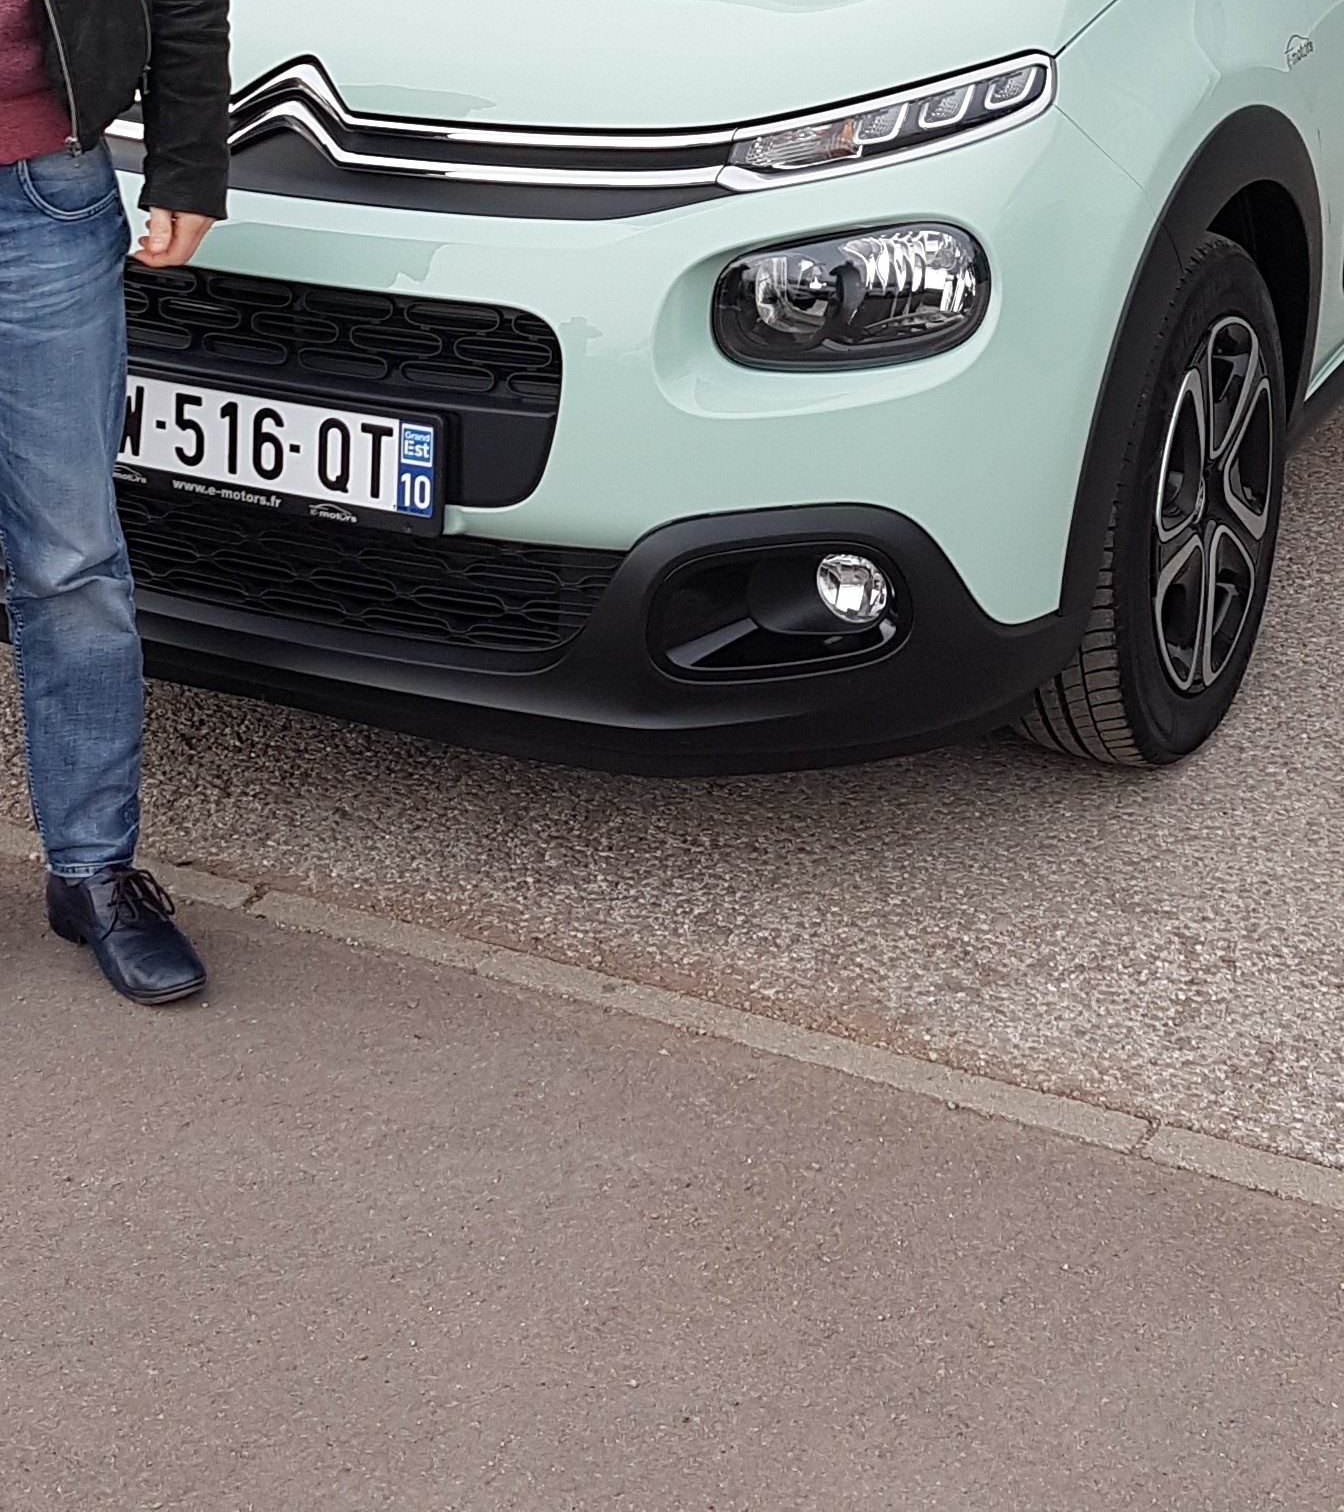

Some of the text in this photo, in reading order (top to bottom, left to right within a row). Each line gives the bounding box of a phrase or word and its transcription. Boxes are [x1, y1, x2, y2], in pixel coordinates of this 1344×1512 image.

[403, 439, 431, 459] Est
[404, 430, 431, 443] Grand
[172, 478, 282, 508] www.e-motors.fr
[400, 472, 431, 510] 10
